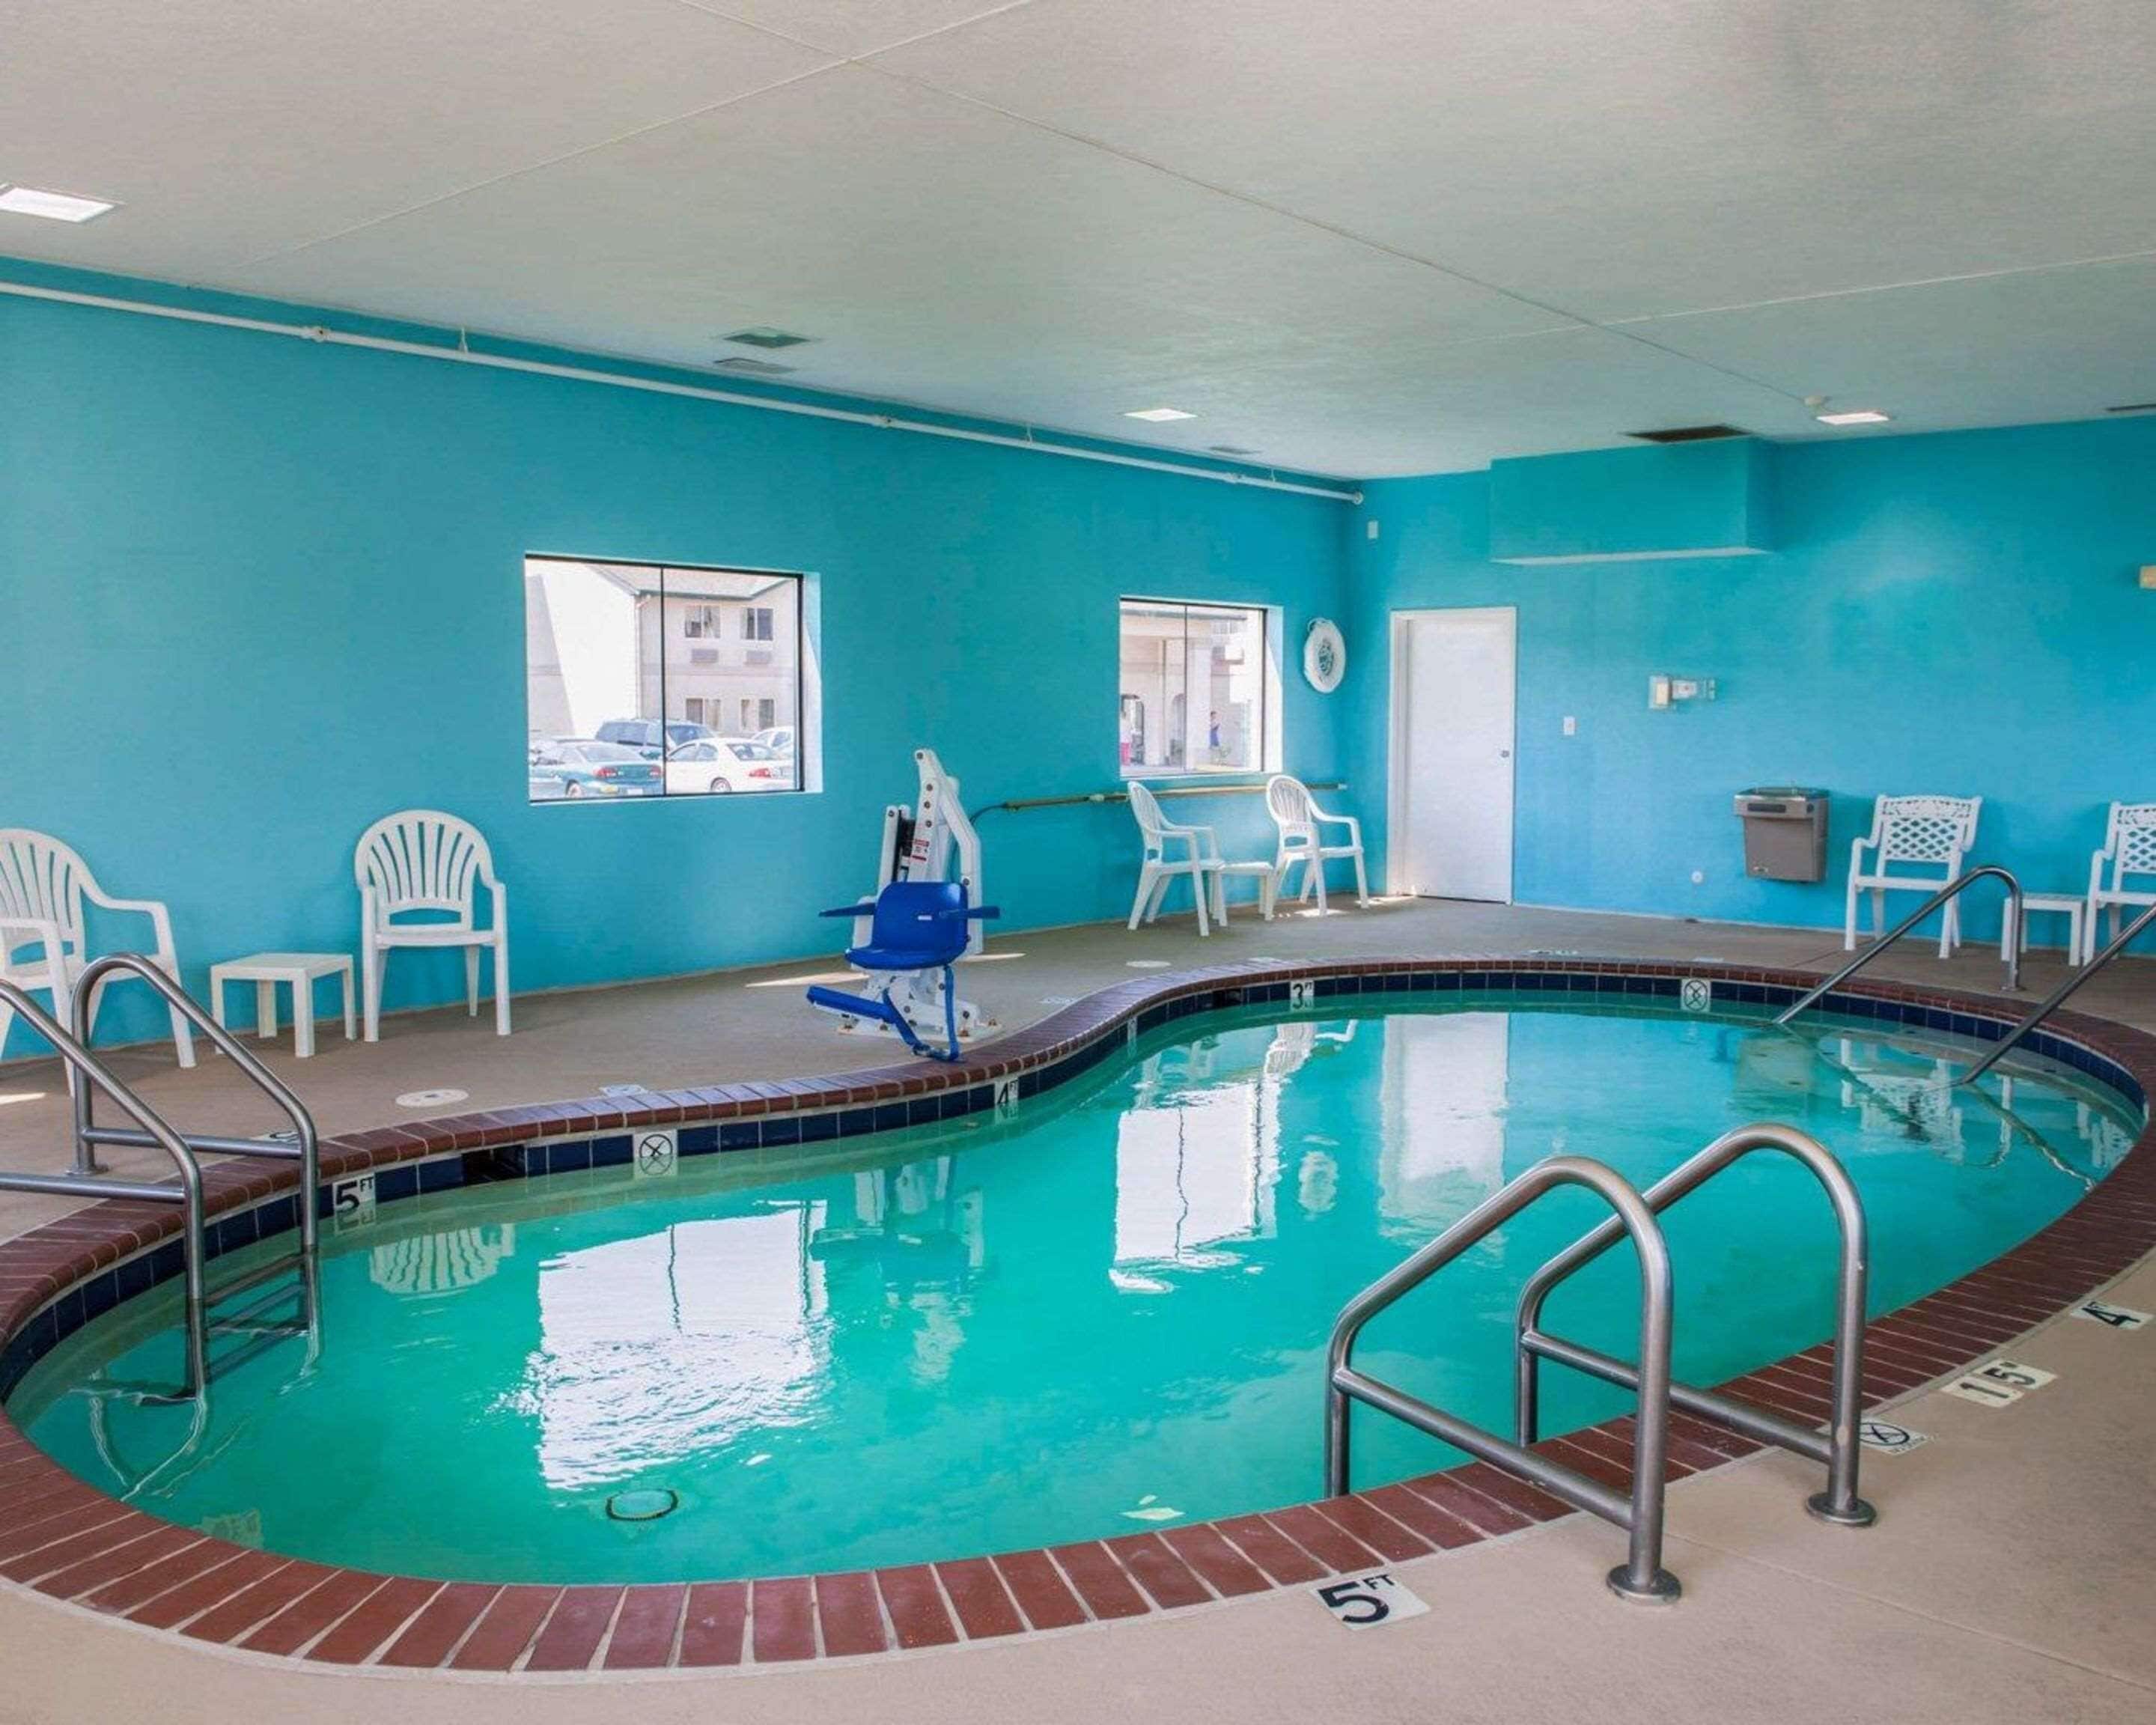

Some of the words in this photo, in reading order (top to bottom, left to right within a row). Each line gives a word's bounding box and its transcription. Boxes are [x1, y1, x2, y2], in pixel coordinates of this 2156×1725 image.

[336, 1180, 359, 1211] 5
[360, 1177, 374, 1192] FT
[2082, 1307, 2141, 1326] 4
[1318, 1581, 1389, 1623] 5
[1362, 1575, 1395, 1589] FT
